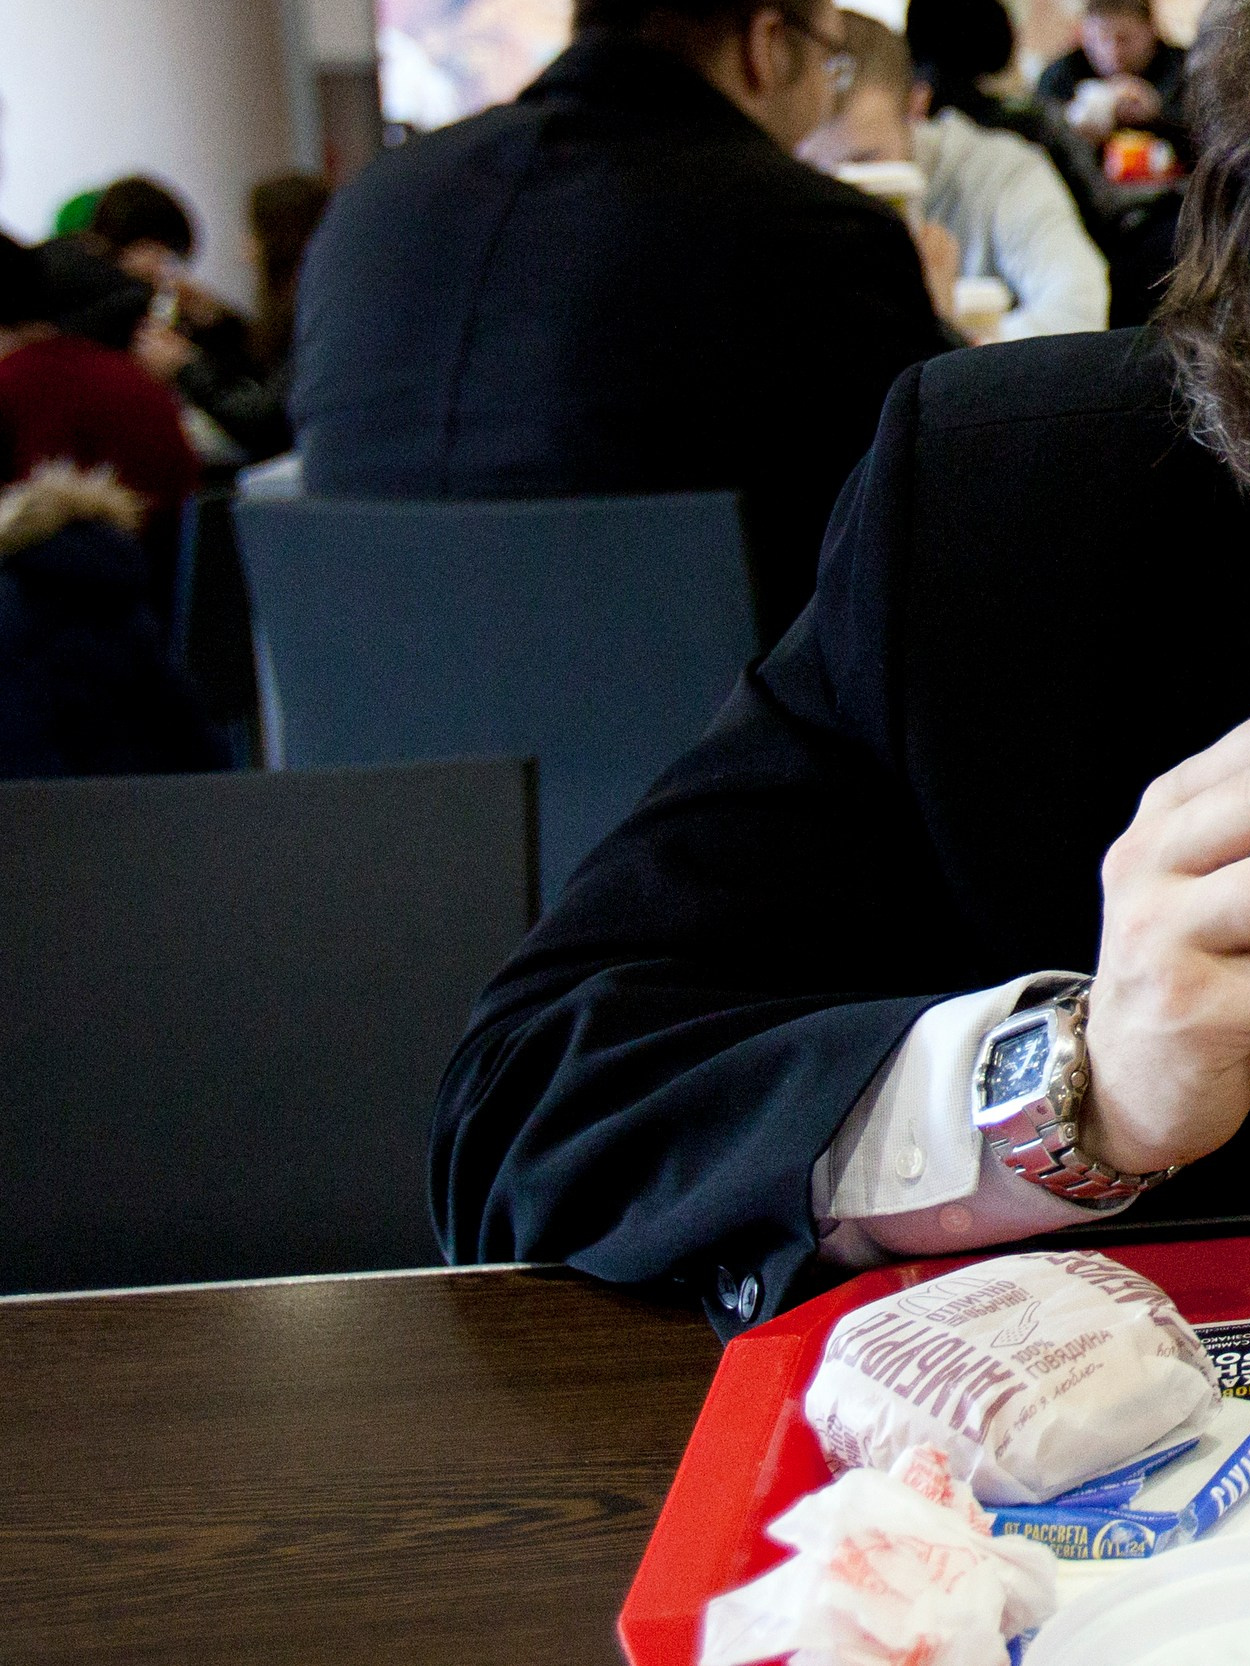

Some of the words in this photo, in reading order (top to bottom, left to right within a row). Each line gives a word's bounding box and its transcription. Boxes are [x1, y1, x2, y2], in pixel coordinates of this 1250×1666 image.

[926, 1279, 1018, 1322] ОТЛИЧНО
[1011, 1339, 1055, 1365] 100%
[1025, 1329, 1114, 1380] ГОВЯДИНА
[824, 1311, 1029, 1446] ГАМБУРГЕ
[1023, 1523, 1089, 1545] РАССВЕТА
